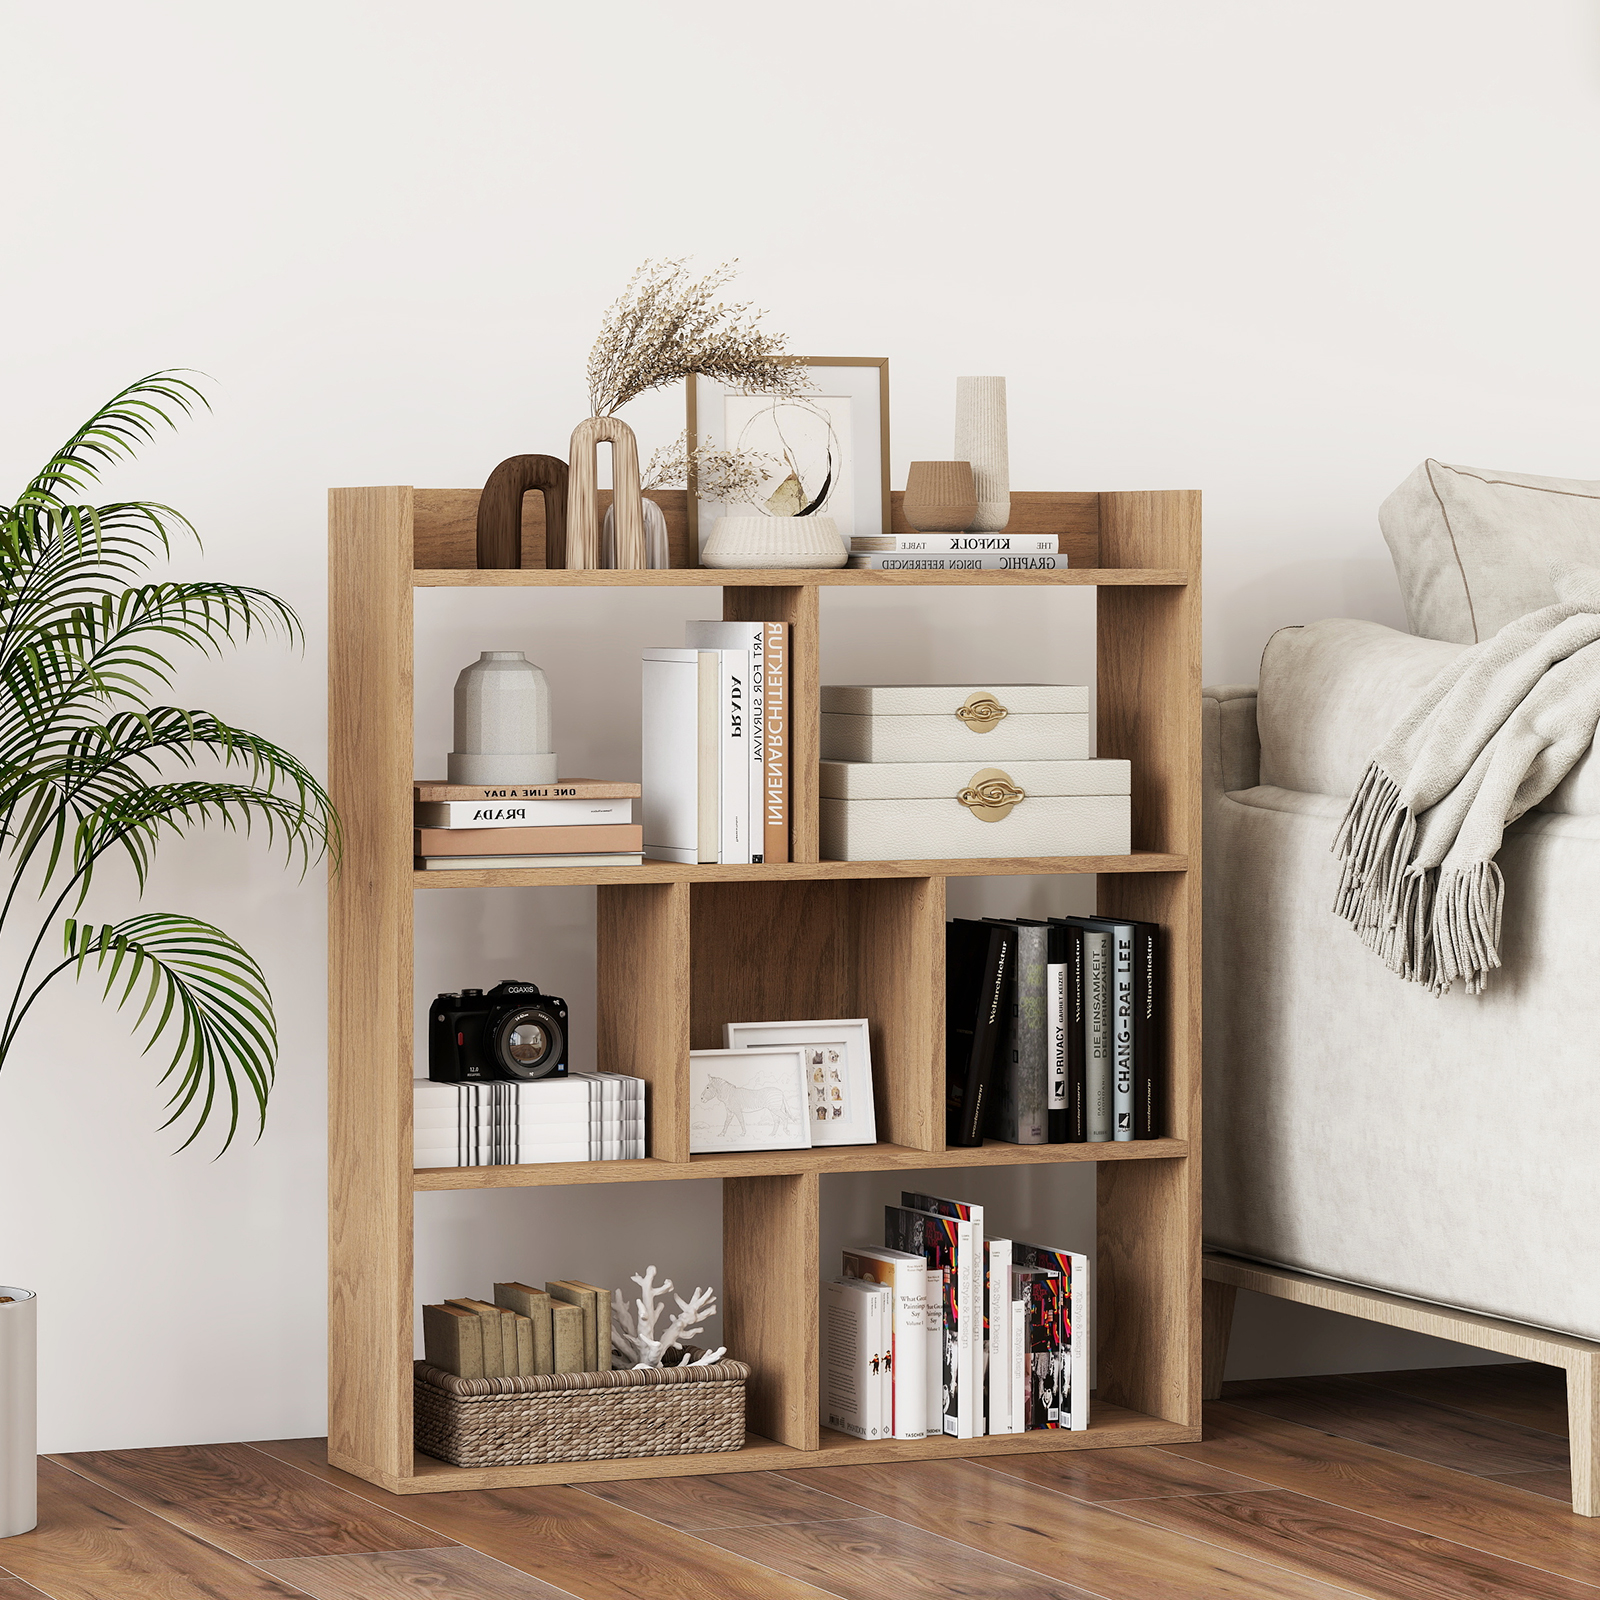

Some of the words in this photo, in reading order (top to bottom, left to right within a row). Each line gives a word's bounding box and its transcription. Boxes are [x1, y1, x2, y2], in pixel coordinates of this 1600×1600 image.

[1117, 940, 1131, 973] LEE
[508, 986, 534, 994] CGAXIS
[988, 941, 1007, 1024] Weltarchitektur
[1092, 951, 1101, 1032] EINSAMKEIT
[1056, 1026, 1064, 1075] PRIVACY
[1093, 1037, 1101, 1058] DIE
[1117, 982, 1131, 1093] CHANG-RAE
